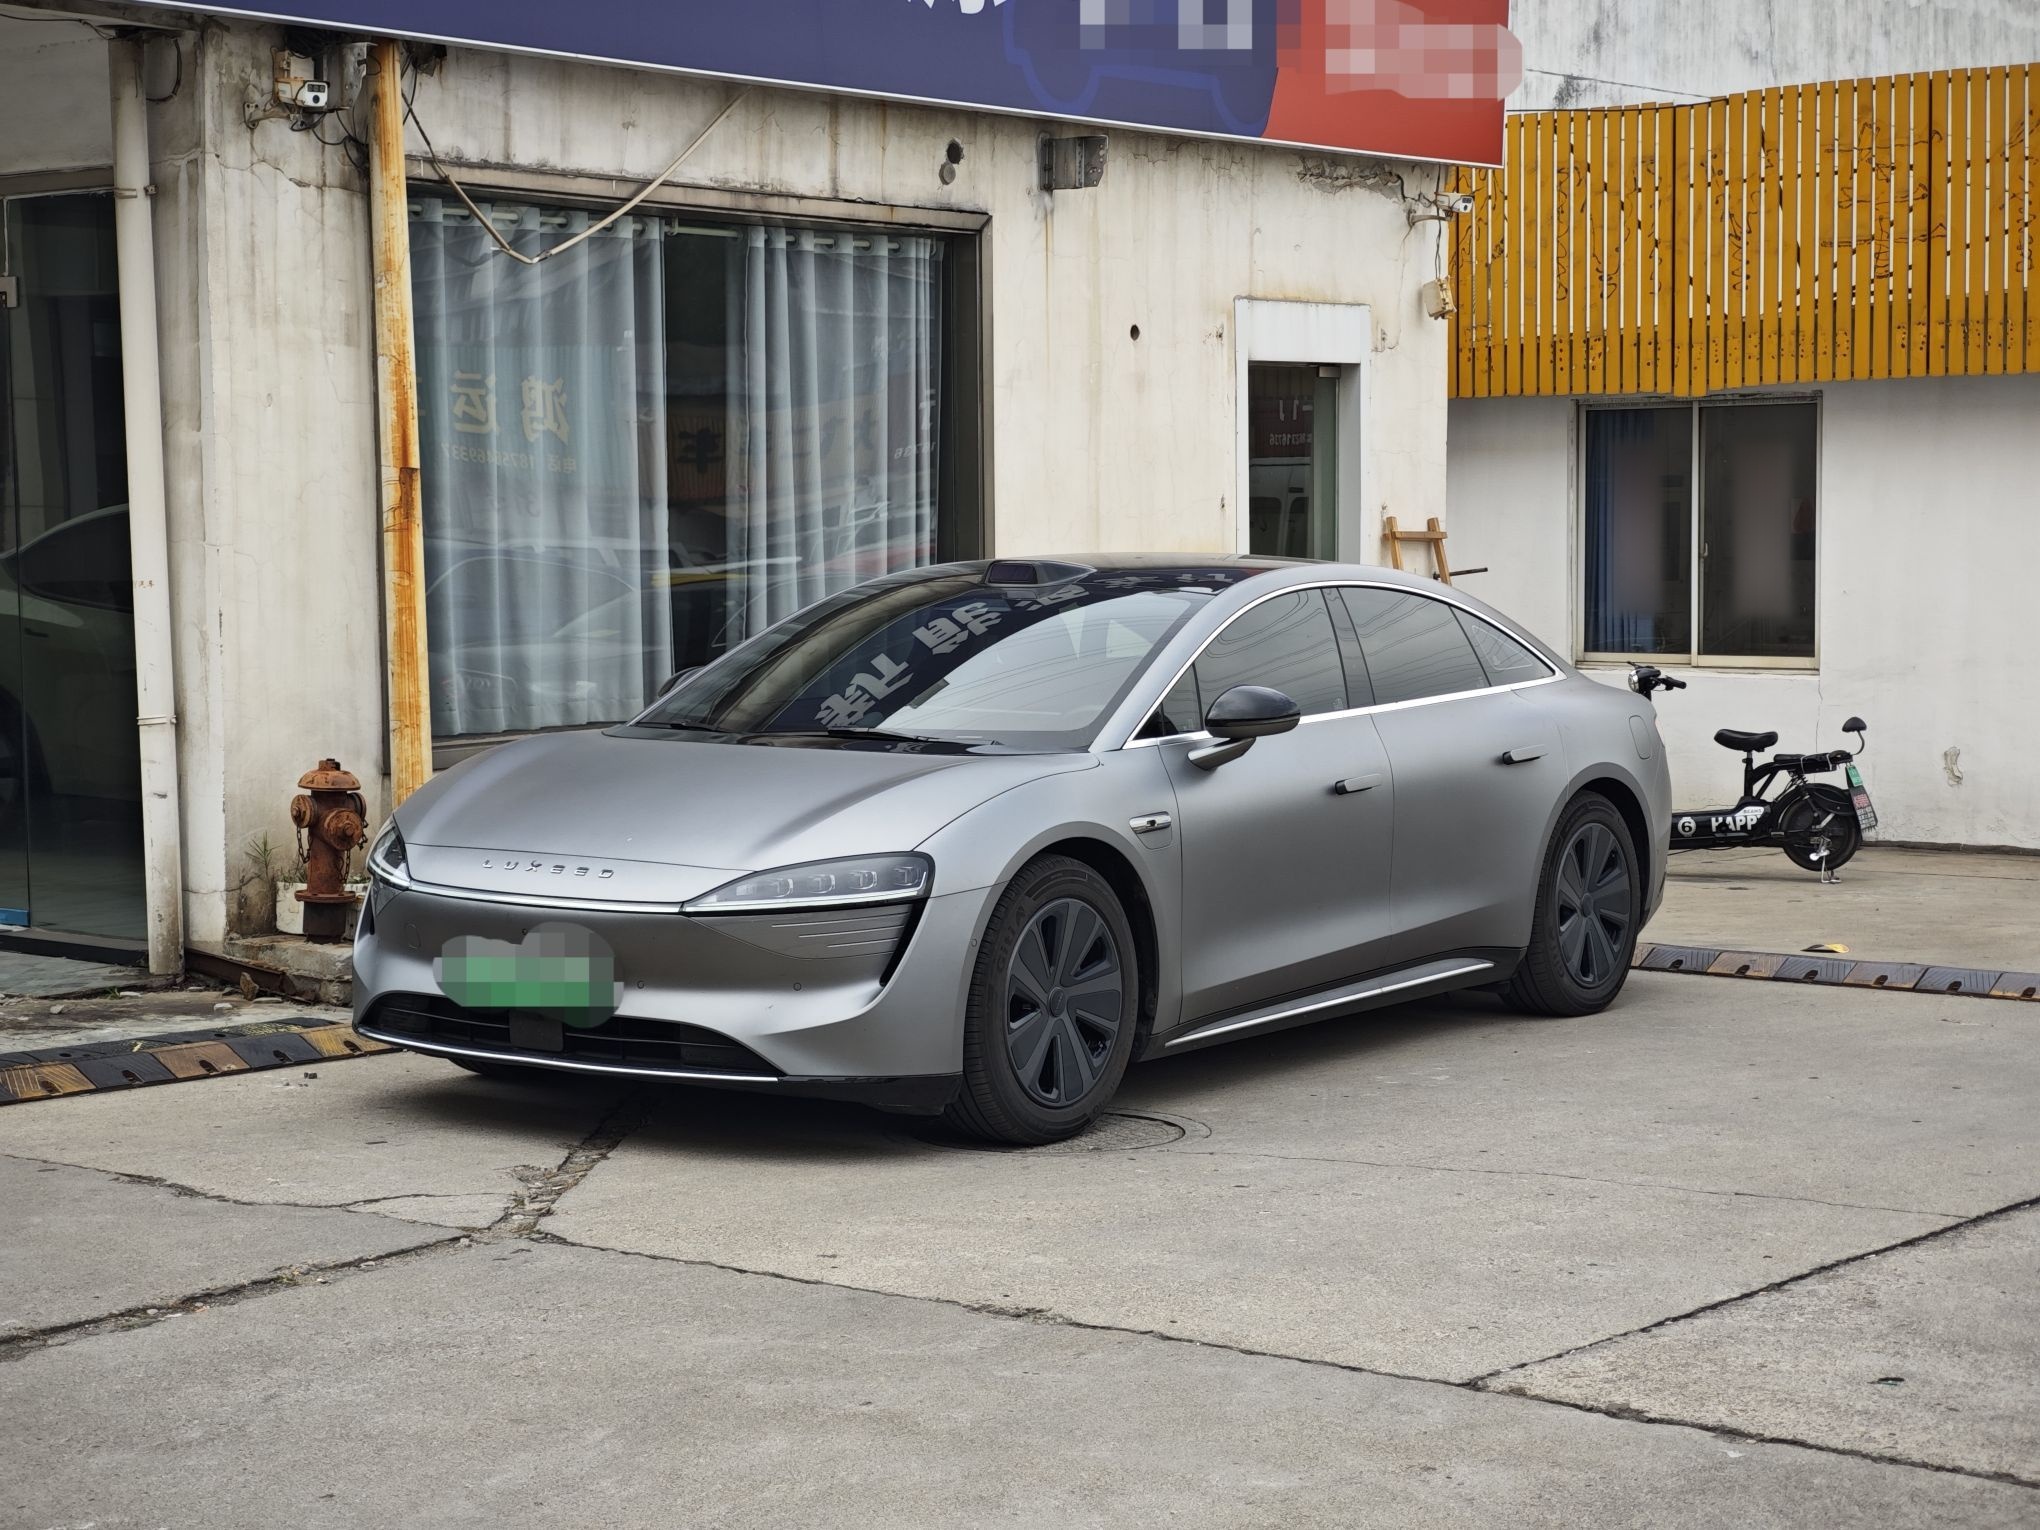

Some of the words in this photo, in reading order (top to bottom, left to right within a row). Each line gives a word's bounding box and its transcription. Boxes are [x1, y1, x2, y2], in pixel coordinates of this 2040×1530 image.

[1681, 821, 1693, 833] 6
[1711, 815, 1761, 832] HAPP
[482, 859, 615, 879] LUXEED
